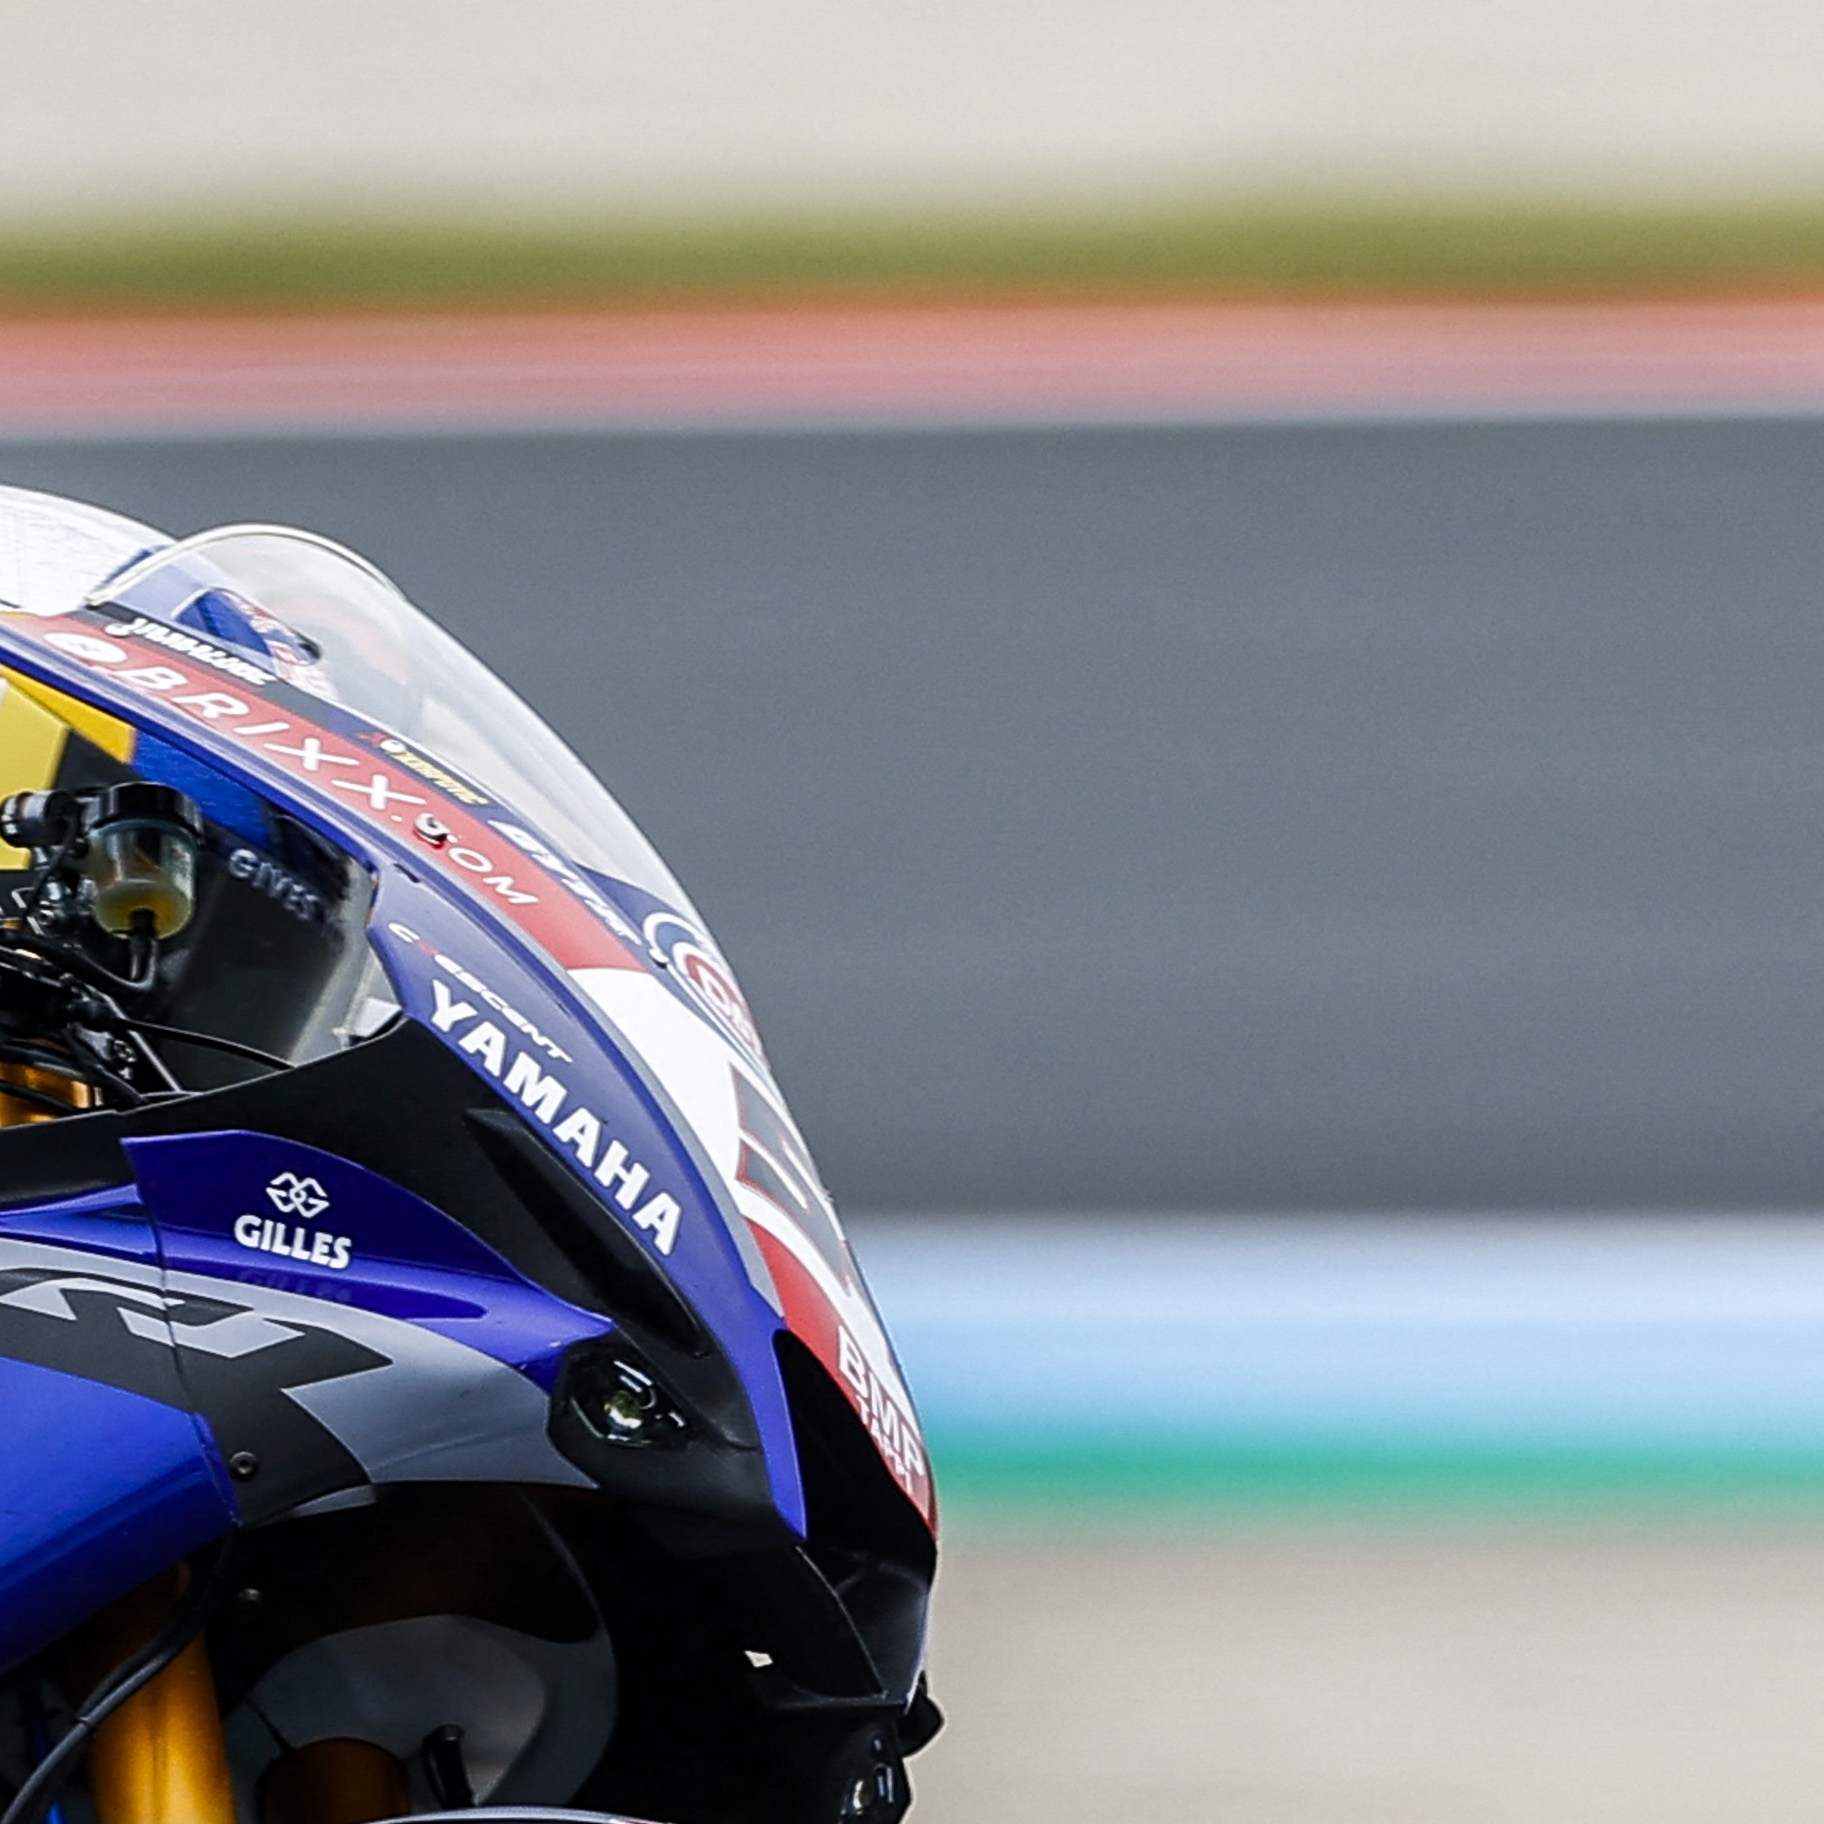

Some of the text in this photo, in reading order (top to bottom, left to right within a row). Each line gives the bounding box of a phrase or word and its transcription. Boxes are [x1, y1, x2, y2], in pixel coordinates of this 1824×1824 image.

[429, 978, 685, 1257] YAMAHA
[234, 1214, 352, 1271] GILLES
[838, 1324, 925, 1476] BMP
